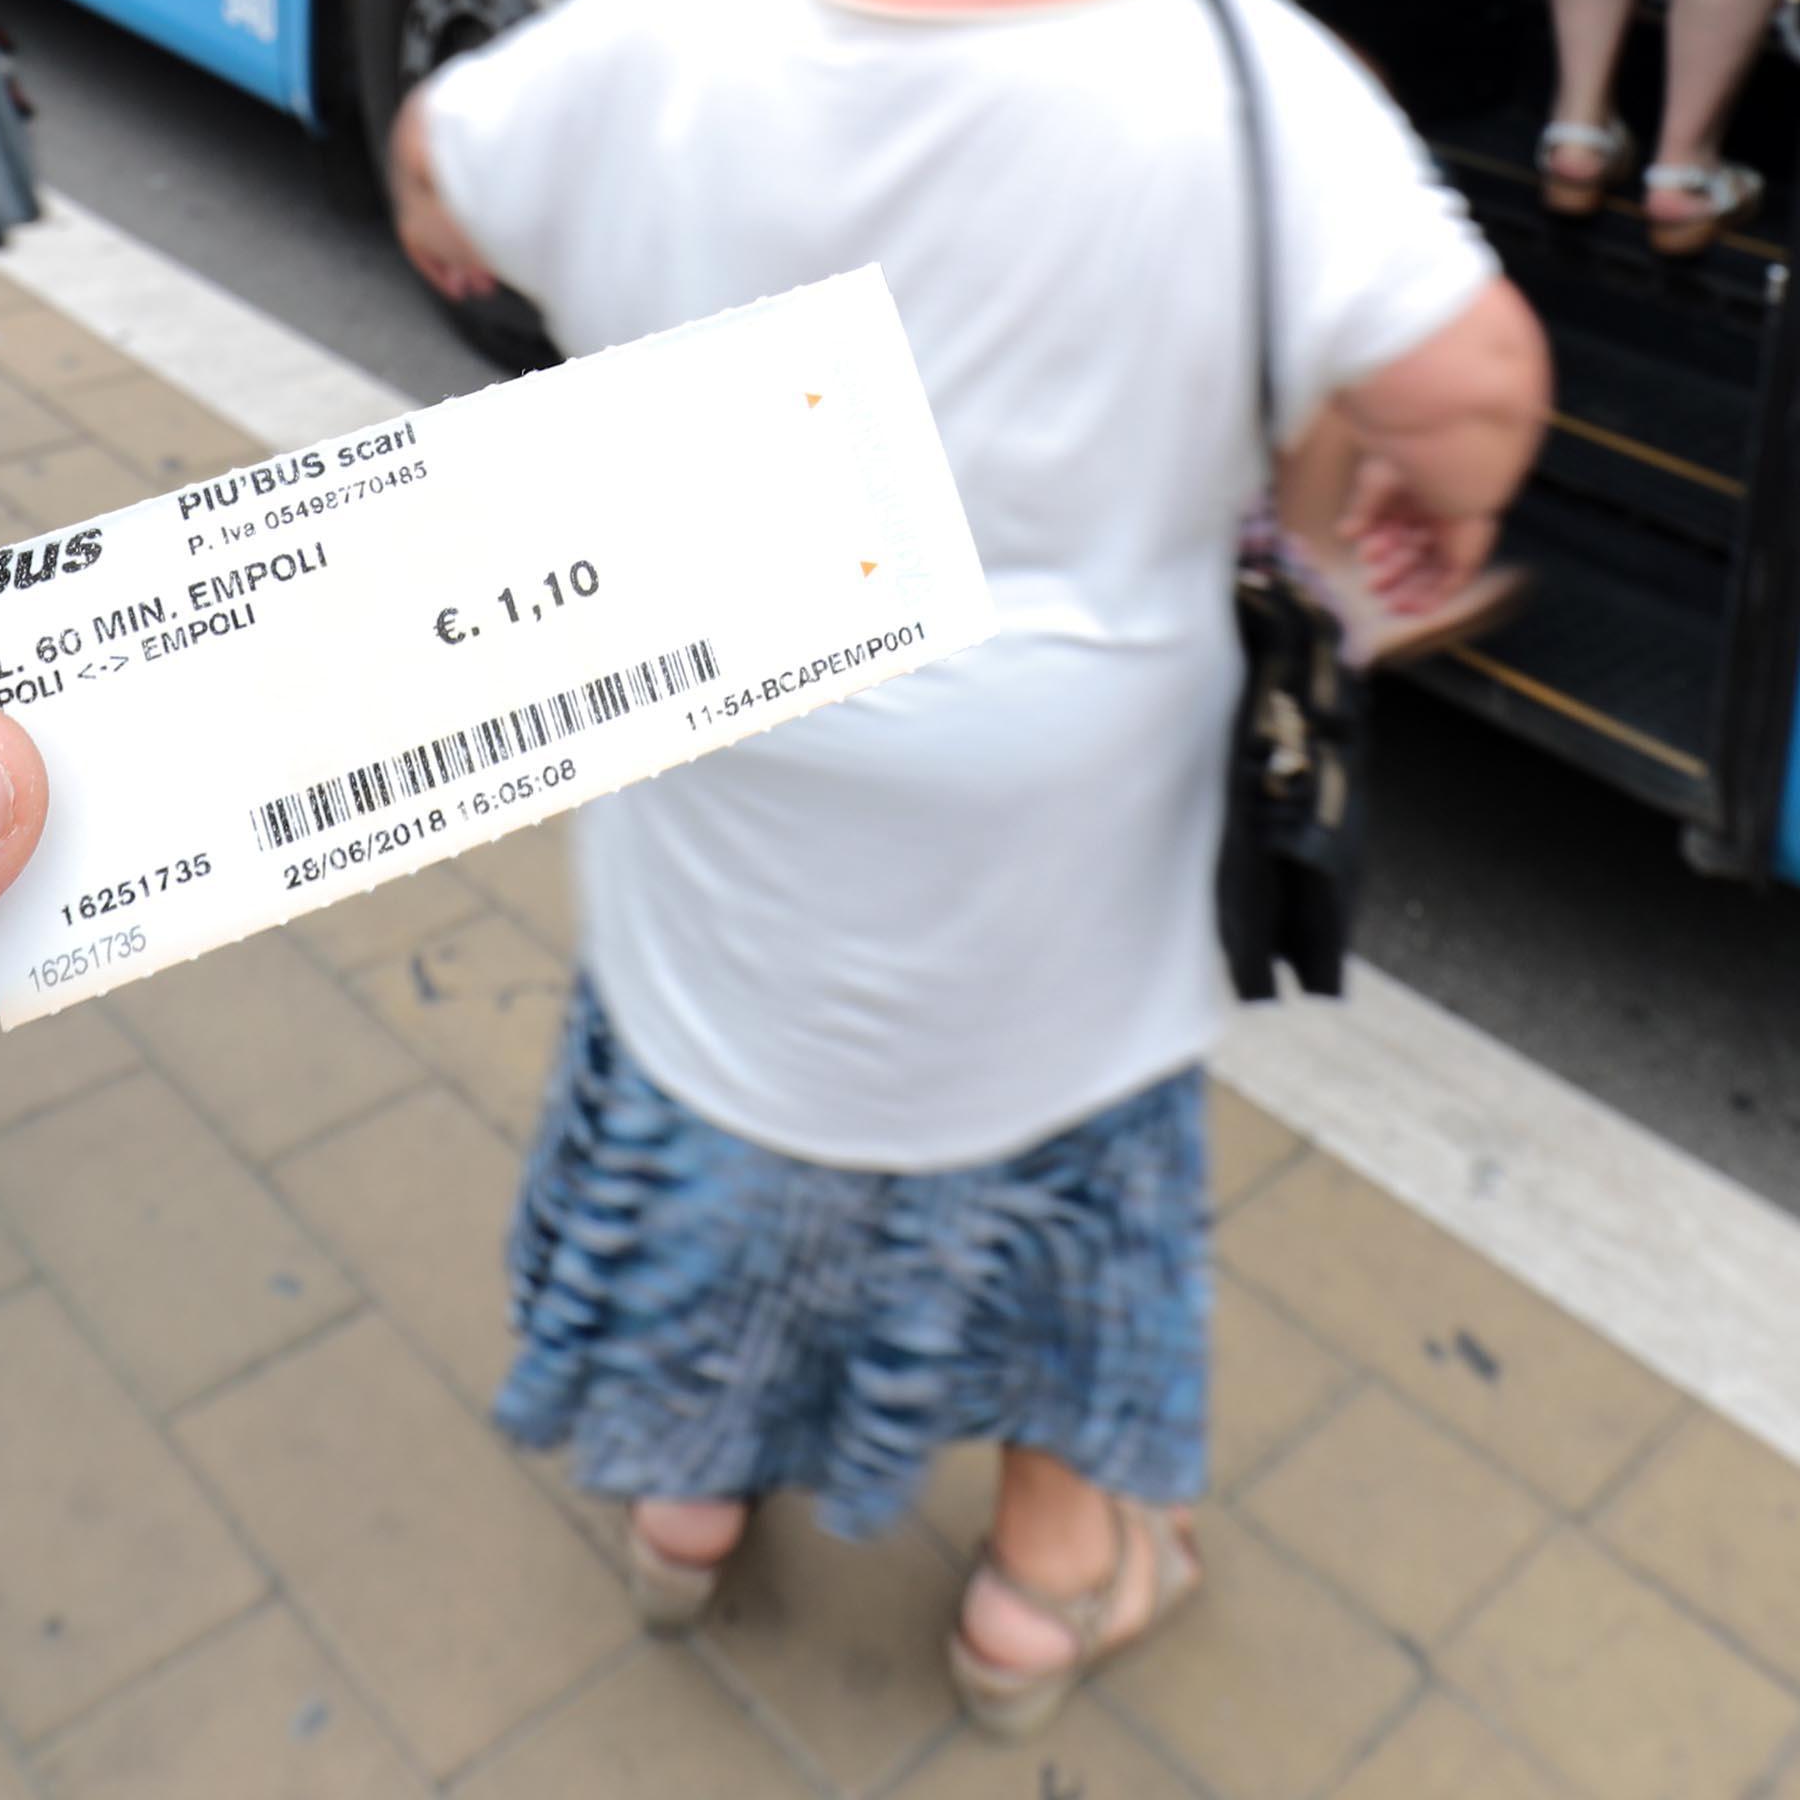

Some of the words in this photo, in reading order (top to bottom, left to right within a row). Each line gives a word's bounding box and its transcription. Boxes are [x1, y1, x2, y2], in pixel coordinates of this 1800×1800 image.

[337, 422, 416, 468] scarl
[188, 534, 213, 555] P.
[221, 522, 256, 545] Iva
[264, 460, 428, 530] 05498770485
[35, 628, 82, 663] 60
[93, 596, 177, 644] MIN.
[188, 542, 328, 611] EMPOLI
[498, 559, 600, 624] 1,10
[141, 603, 256, 662] EMPOLI
[685, 621, 925, 731] 11-54-BCAPEMP001
[284, 808, 447, 890] 28/06/2018
[456, 758, 577, 822] 16:05:08
[61, 852, 212, 928] 16251735
[28, 925, 147, 993] 16251735
